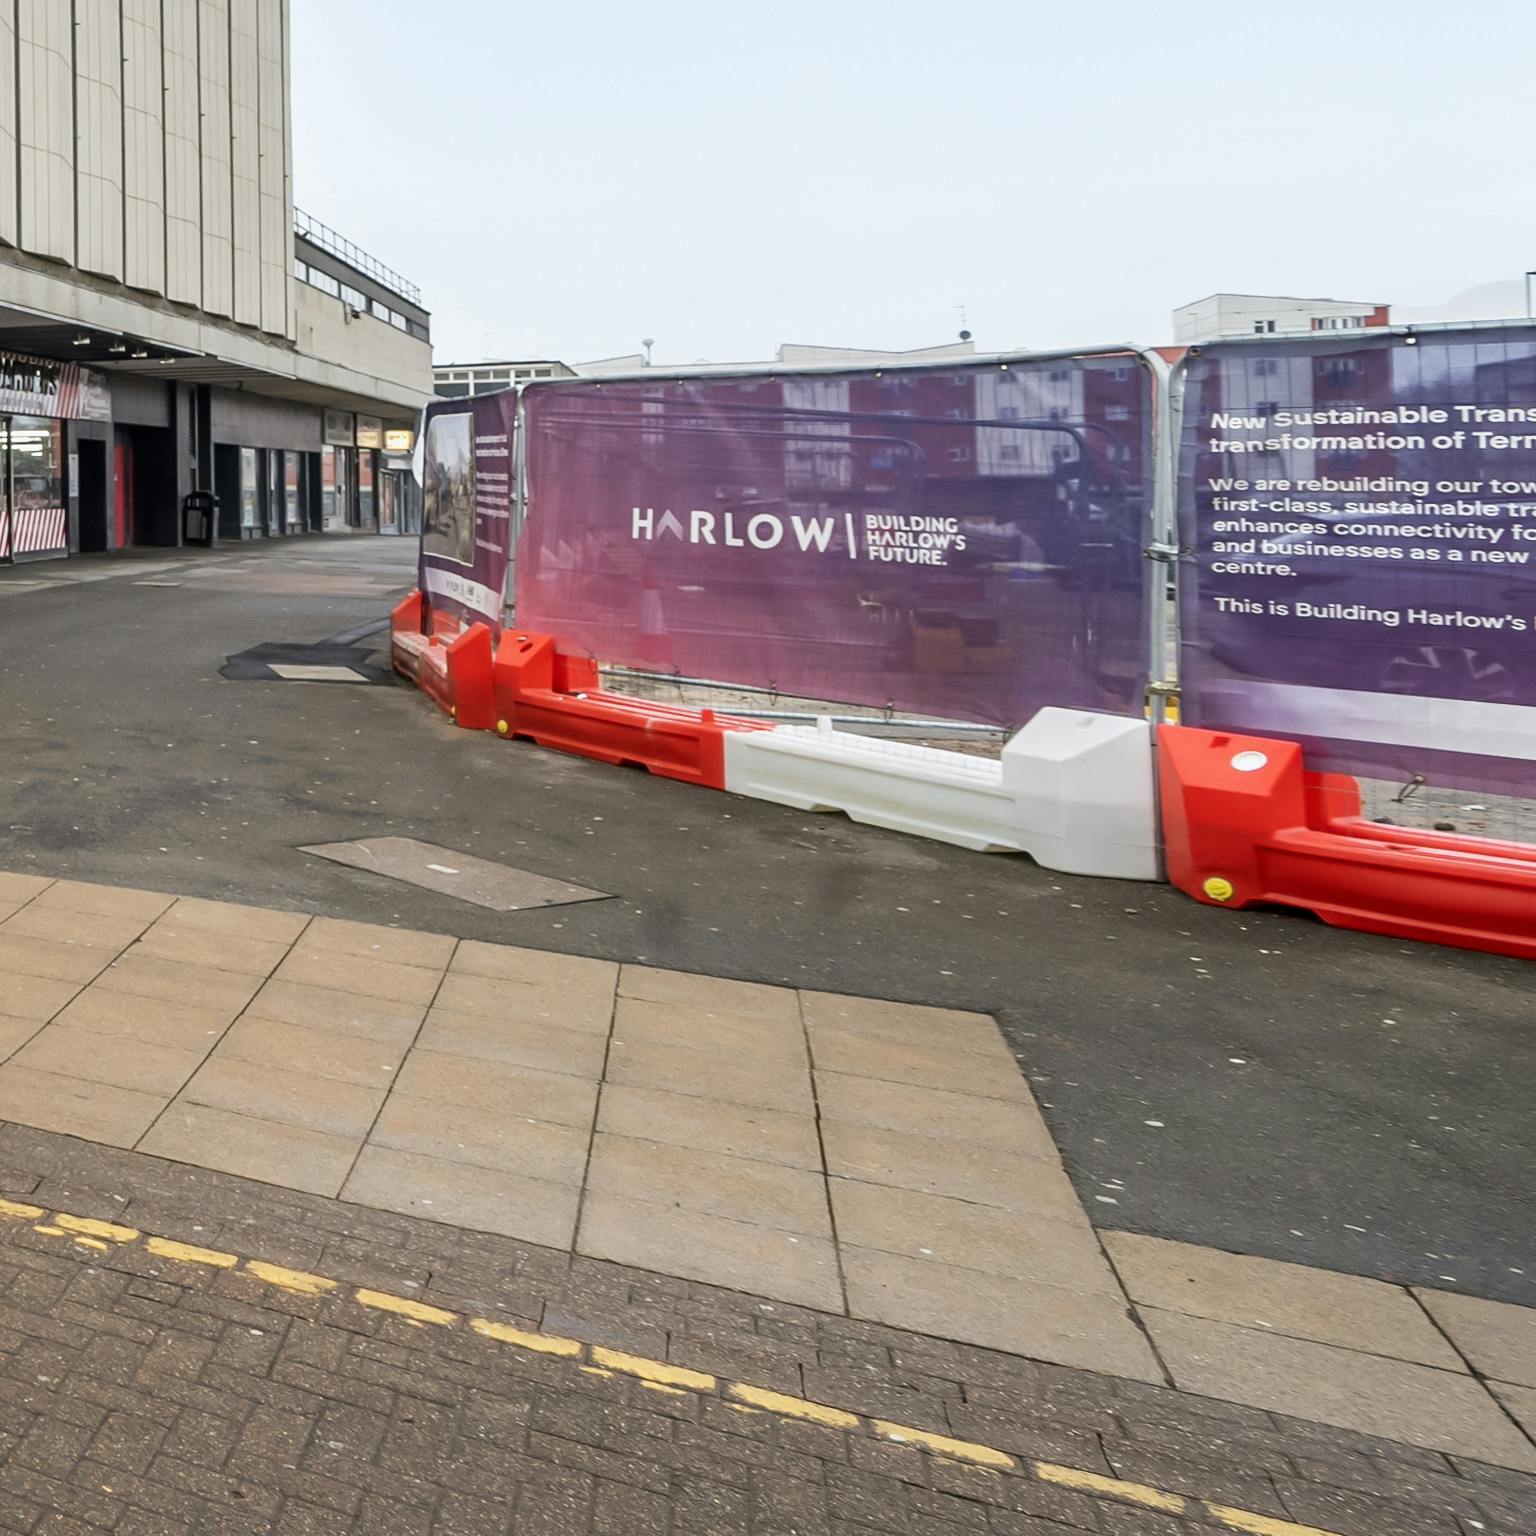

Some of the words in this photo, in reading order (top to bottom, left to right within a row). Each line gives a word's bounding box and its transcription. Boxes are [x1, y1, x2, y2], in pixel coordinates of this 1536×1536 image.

[1210, 412, 1266, 430] New
[1273, 406, 1449, 428] Sustainable
[1454, 405, 1536, 423] Trans
[1209, 431, 1426, 453] transformation
[1431, 431, 1466, 449] of
[1208, 478, 1249, 492] We
[1254, 478, 1291, 492] are
[1296, 476, 1430, 497] rebuilding
[1436, 480, 1484, 494] our
[1212, 496, 1339, 515] first-class,
[1344, 499, 1501, 517] sustainable
[1506, 502, 1536, 518] tr
[631, 507, 835, 553] HARLOW
[865, 514, 959, 534] BUILDING
[1212, 517, 1328, 535] enhances
[1333, 521, 1505, 544] connectivity
[866, 531, 967, 551] HARLOW'S
[1212, 539, 1256, 554] and
[1261, 541, 1405, 560] businesses
[1409, 547, 1441, 562] as
[1446, 548, 1463, 562] a
[1470, 550, 1530, 564] new
[868, 547, 949, 566] FUTURE.
[1211, 561, 1298, 577] centre.
[1213, 597, 1264, 615] This
[1269, 599, 1289, 616] is
[1295, 602, 1401, 626] Building
[1407, 608, 1528, 631] Harlow's
